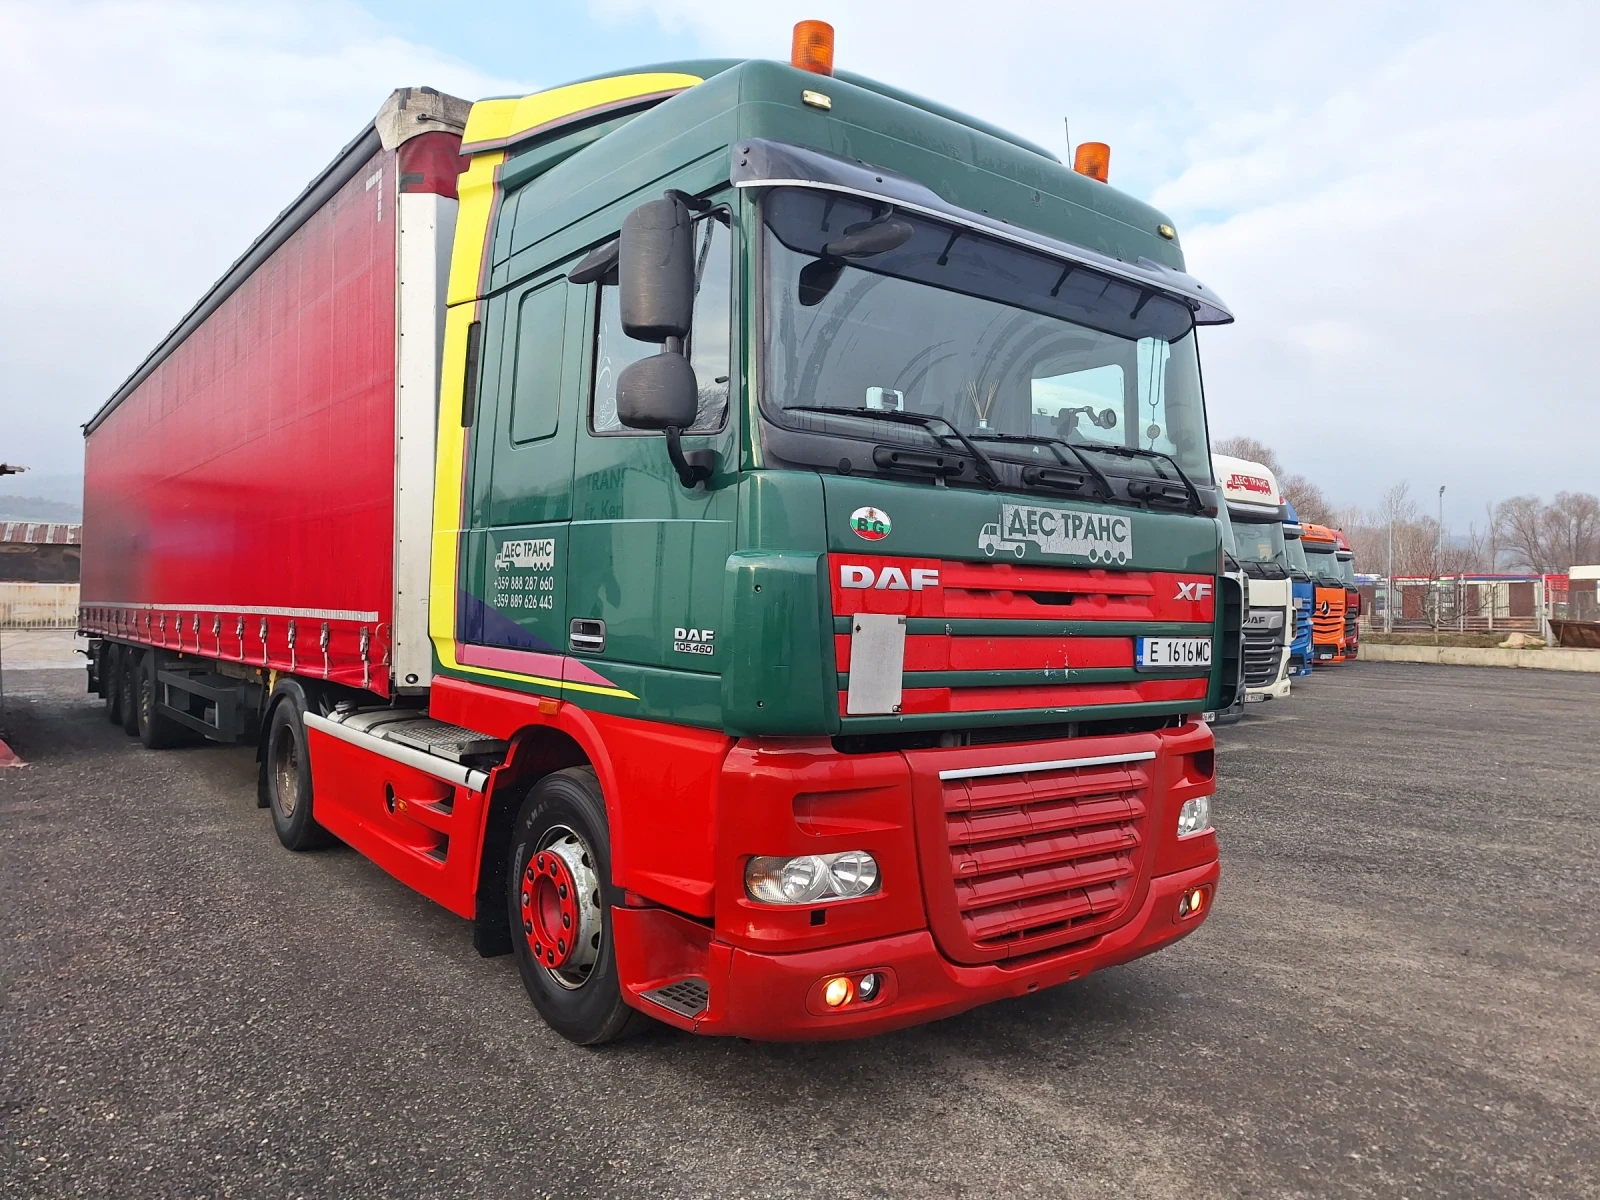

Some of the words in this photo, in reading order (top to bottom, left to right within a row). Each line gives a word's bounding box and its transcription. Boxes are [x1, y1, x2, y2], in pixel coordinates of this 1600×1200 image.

[857, 517, 884, 535] BG
[1008, 508, 1056, 539] ДЕС
[1060, 513, 1127, 543] ТРАНС
[504, 543, 521, 559] ДЕС
[524, 541, 552, 558] ТРАНС
[493, 576, 509, 590] +359
[510, 576, 523, 590] 888
[524, 576, 538, 590] 287
[540, 576, 554, 591] 660
[840, 564, 940, 591] DAF
[1173, 582, 1213, 601] XF
[493, 594, 509, 607] +359
[510, 594, 523, 608] 889
[524, 594, 538, 609] 626
[539, 595, 553, 610] 443
[674, 627, 714, 642] DAF
[675, 642, 713, 654] 105.460
[1151, 641, 1159, 662] E
